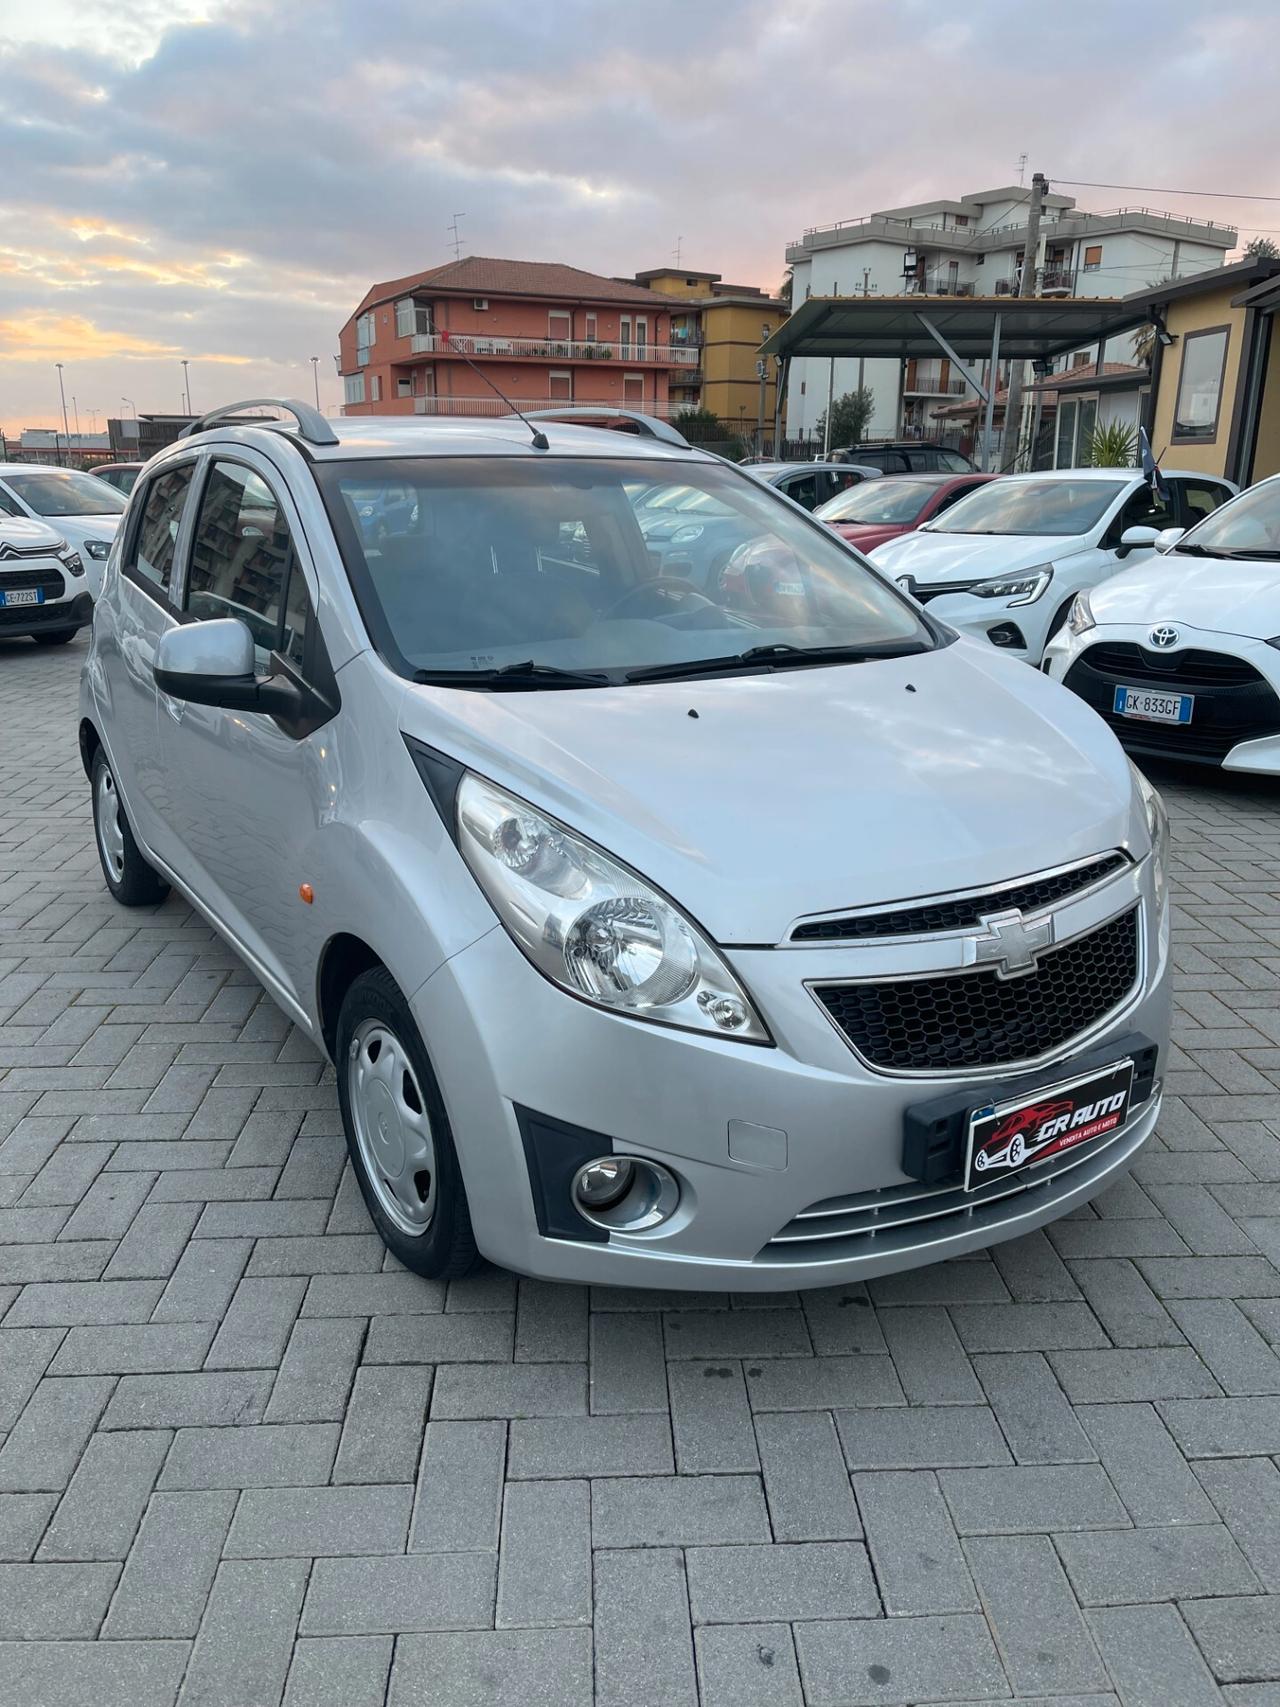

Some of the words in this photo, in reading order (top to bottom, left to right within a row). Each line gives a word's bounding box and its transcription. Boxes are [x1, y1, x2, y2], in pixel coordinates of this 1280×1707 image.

[1059, 1132, 1082, 1147] VENDITA
[1081, 1125, 1098, 1137] AUTO
[1102, 1116, 1118, 1129] MOTO
